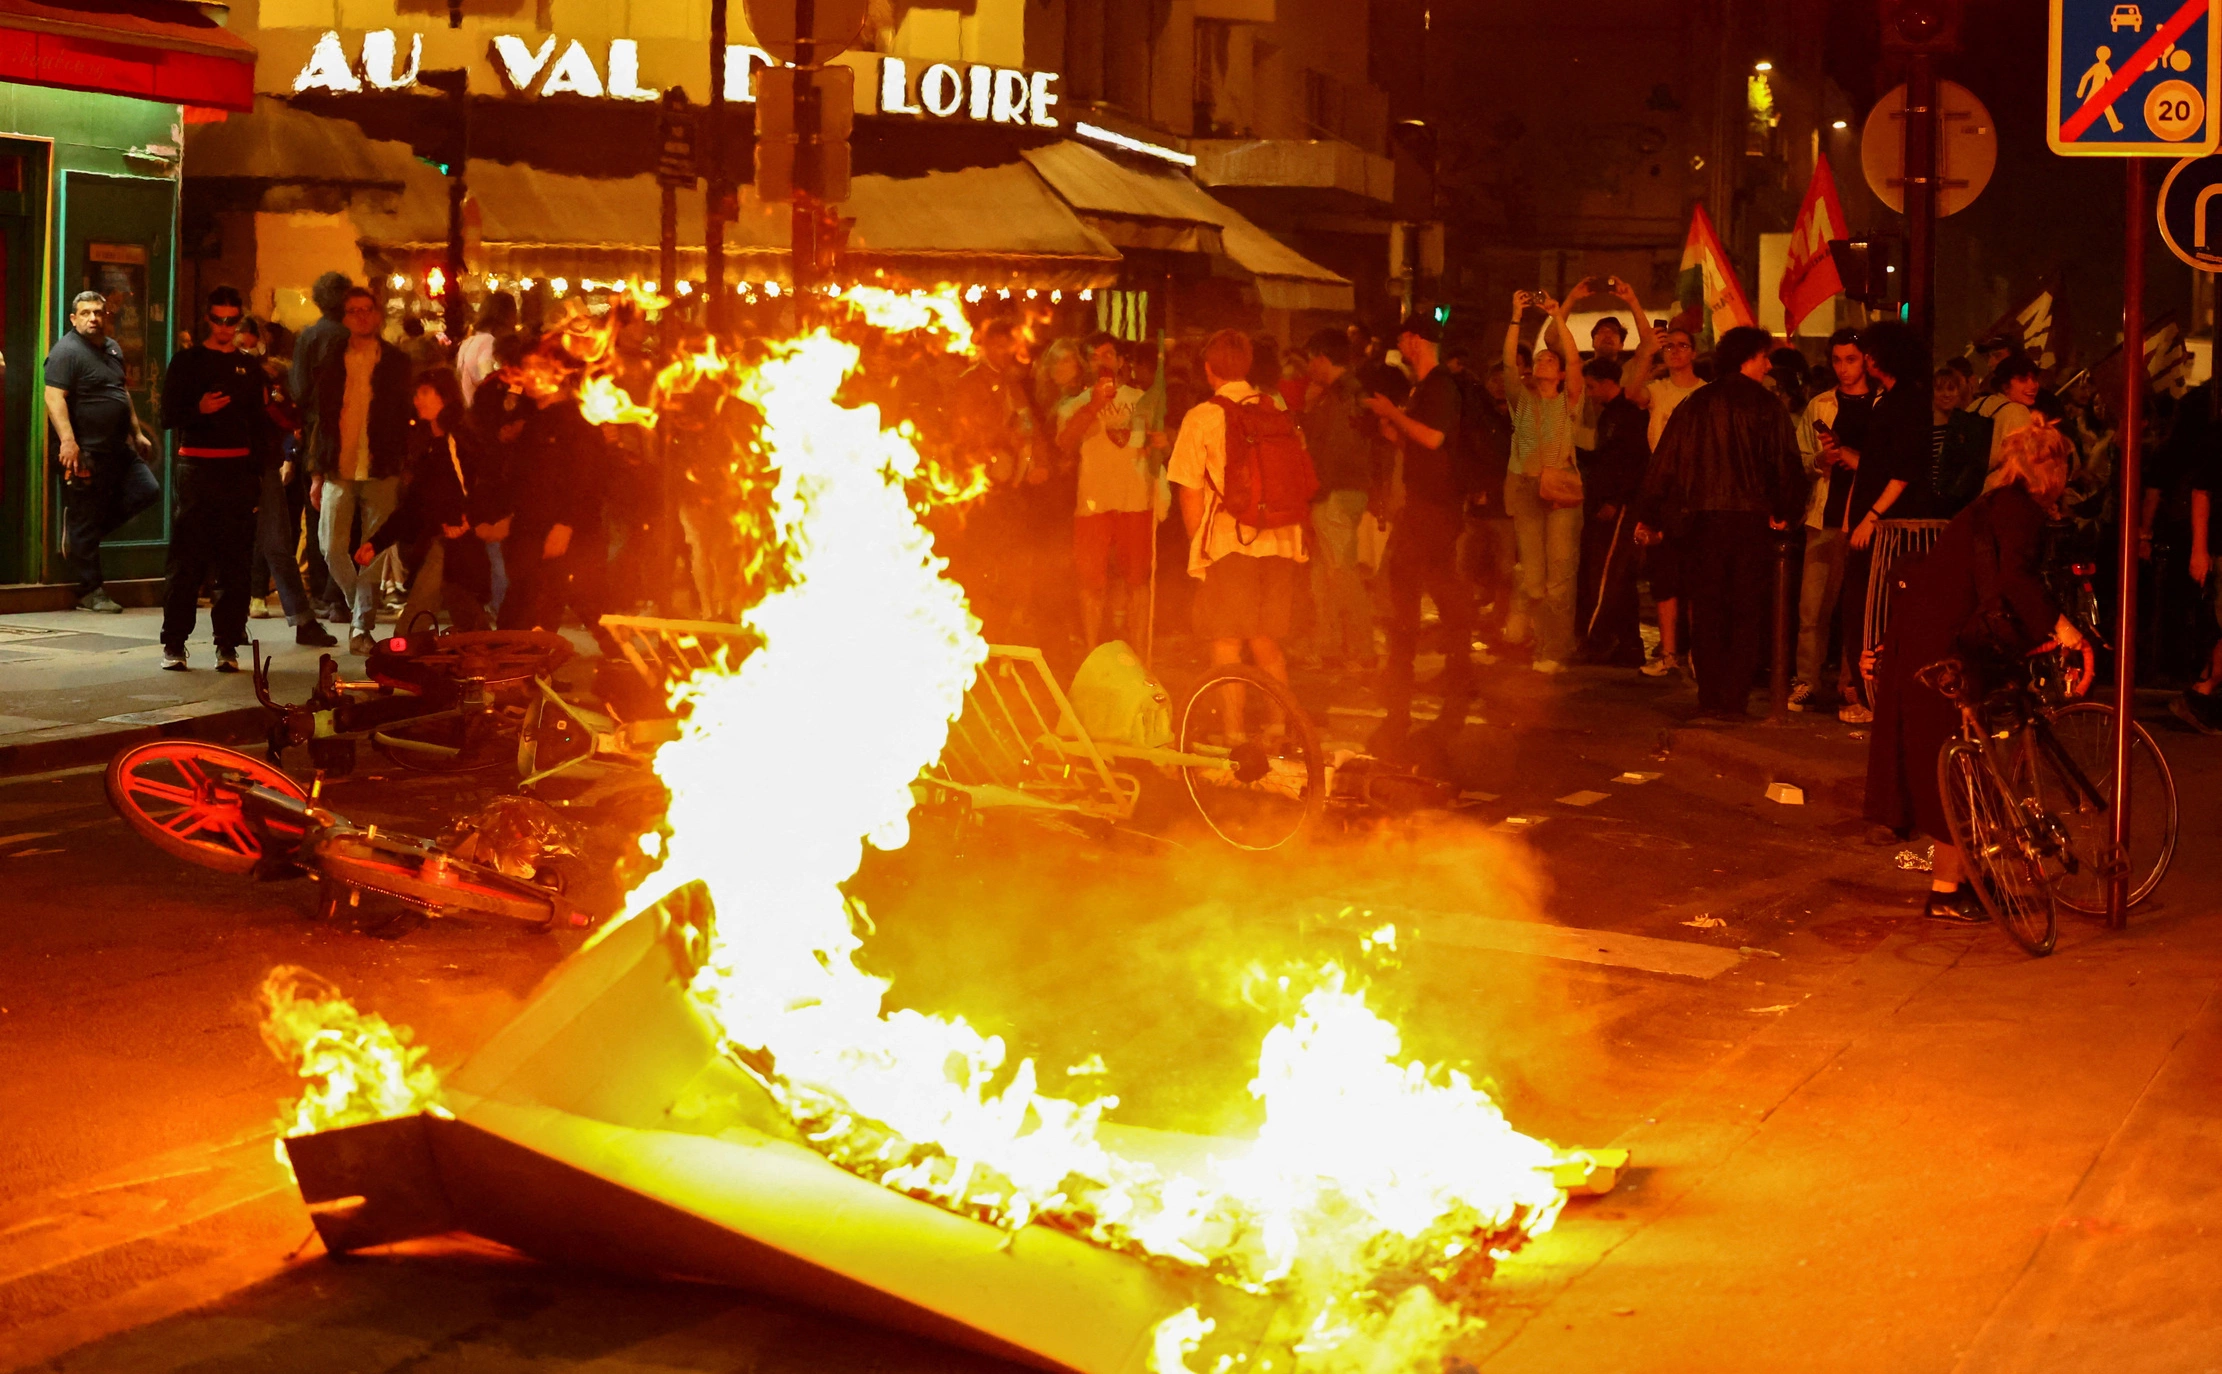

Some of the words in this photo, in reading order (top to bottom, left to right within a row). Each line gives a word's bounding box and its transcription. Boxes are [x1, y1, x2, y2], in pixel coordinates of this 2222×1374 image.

[293, 30, 423, 94] AU
[493, 34, 660, 101] VAL
[882, 57, 1059, 127] LOIRE
[2159, 101, 2190, 121] 20
